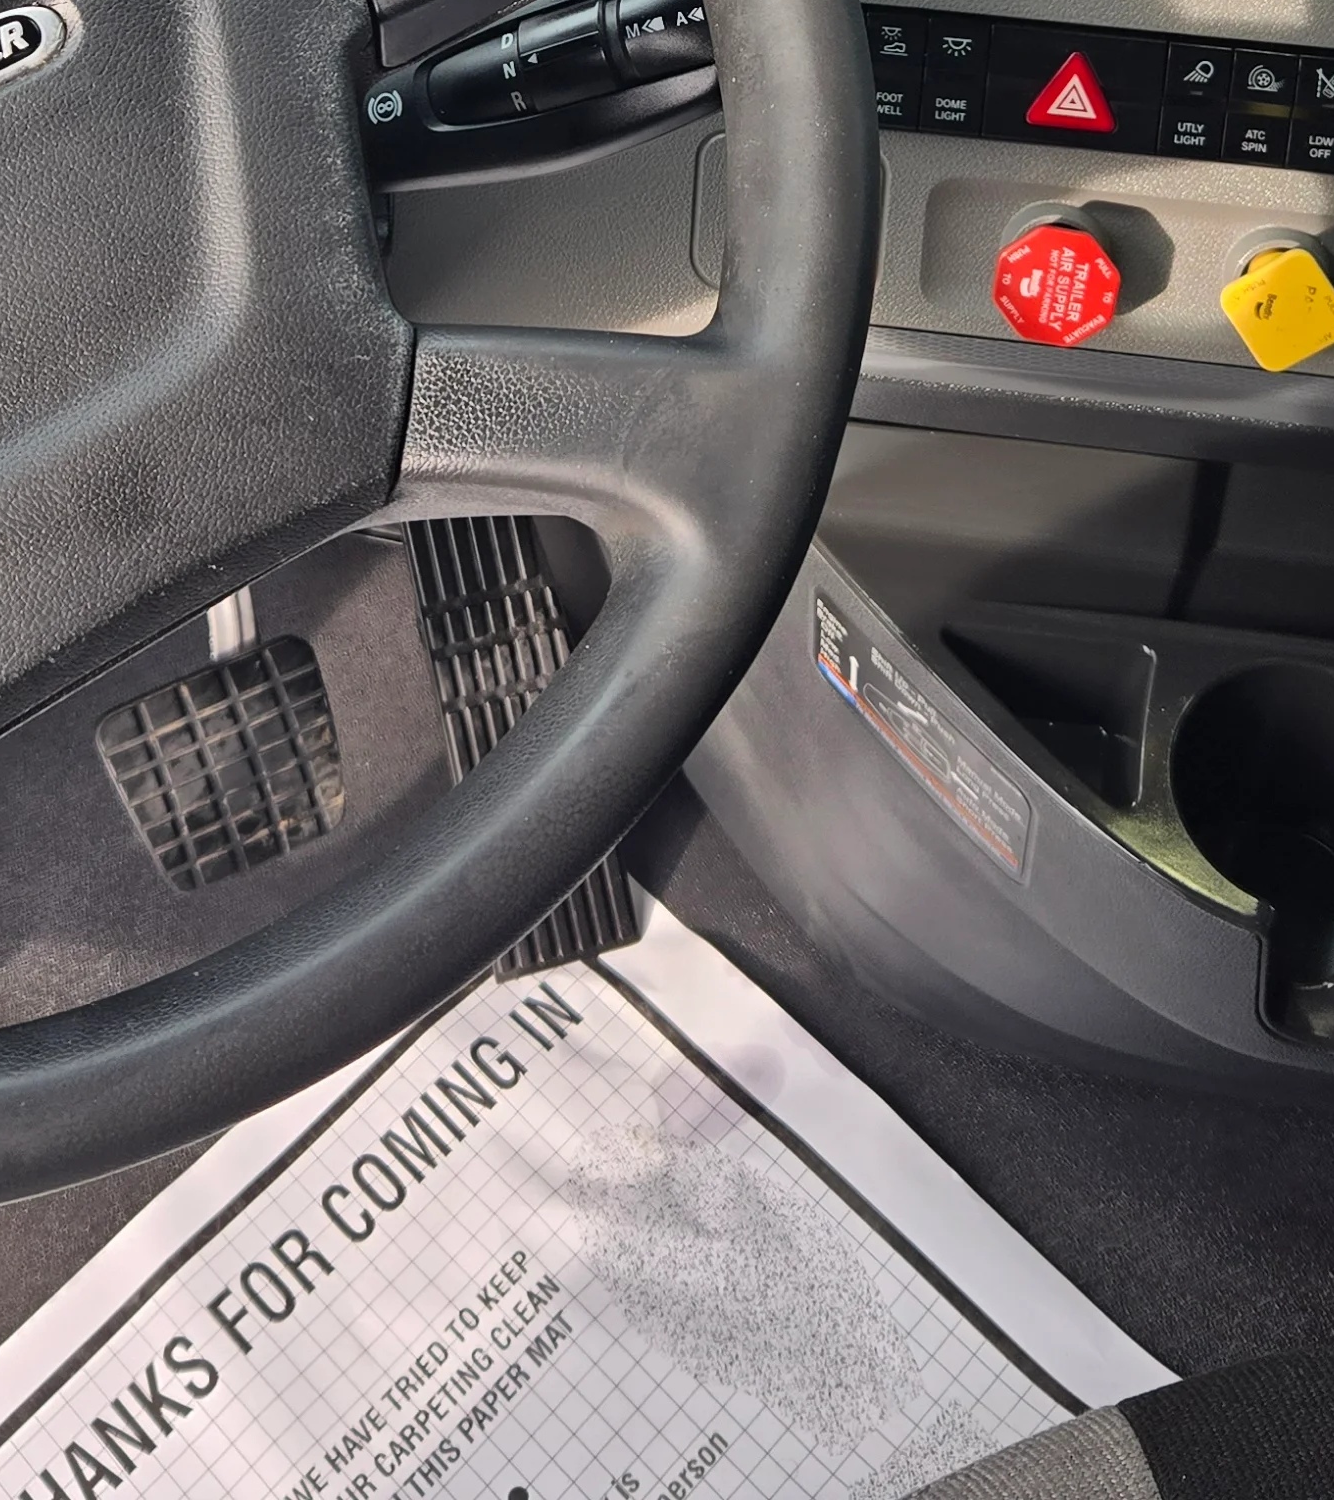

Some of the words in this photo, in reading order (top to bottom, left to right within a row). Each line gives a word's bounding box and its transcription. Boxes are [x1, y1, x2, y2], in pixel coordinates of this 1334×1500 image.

[676, 10, 689, 27] A
[501, 32, 513, 49] D
[625, 25, 641, 40] M
[502, 60, 516, 79] N
[511, 91, 526, 112] R
[876, 91, 904, 104] FOOT
[935, 97, 967, 110] DOME
[934, 110, 966, 122] LIGHT
[1177, 121, 1205, 134] UTLY
[1245, 128, 1266, 141] ATC
[1173, 134, 1206, 147] LIGHT
[1241, 140, 1267, 153] SPIN
[1309, 135, 1334, 147] LDW
[1309, 147, 1331, 160] OFF
[1050, 249, 1060, 268] NOT
[1059, 246, 1075, 272] AIR
[1002, 273, 1012, 285] TO
[1066, 263, 1090, 322] TRAILER
[1102, 291, 1114, 304] TO
[999, 295, 1025, 324] SUPPLY
[1048, 275, 1070, 332] SUPPLY
[1063, 314, 1107, 343] EVACUATE
[208, 1227, 335, 1355] FOR
[321, 1035, 528, 1244] COMING
[511, 980, 584, 1053] IN
[325, 1406, 387, 1473] HAVE
[382, 1341, 449, 1411] TRIED
[445, 1307, 480, 1342] TO
[477, 1250, 530, 1311] KEEP
[374, 1348, 494, 1477] CARPETING
[490, 1274, 561, 1350] CLEAN
[403, 1438, 461, 1498] THIS
[457, 1363, 531, 1443] PAPER
[525, 1309, 573, 1367] MAT
[611, 1472, 640, 1500] is
